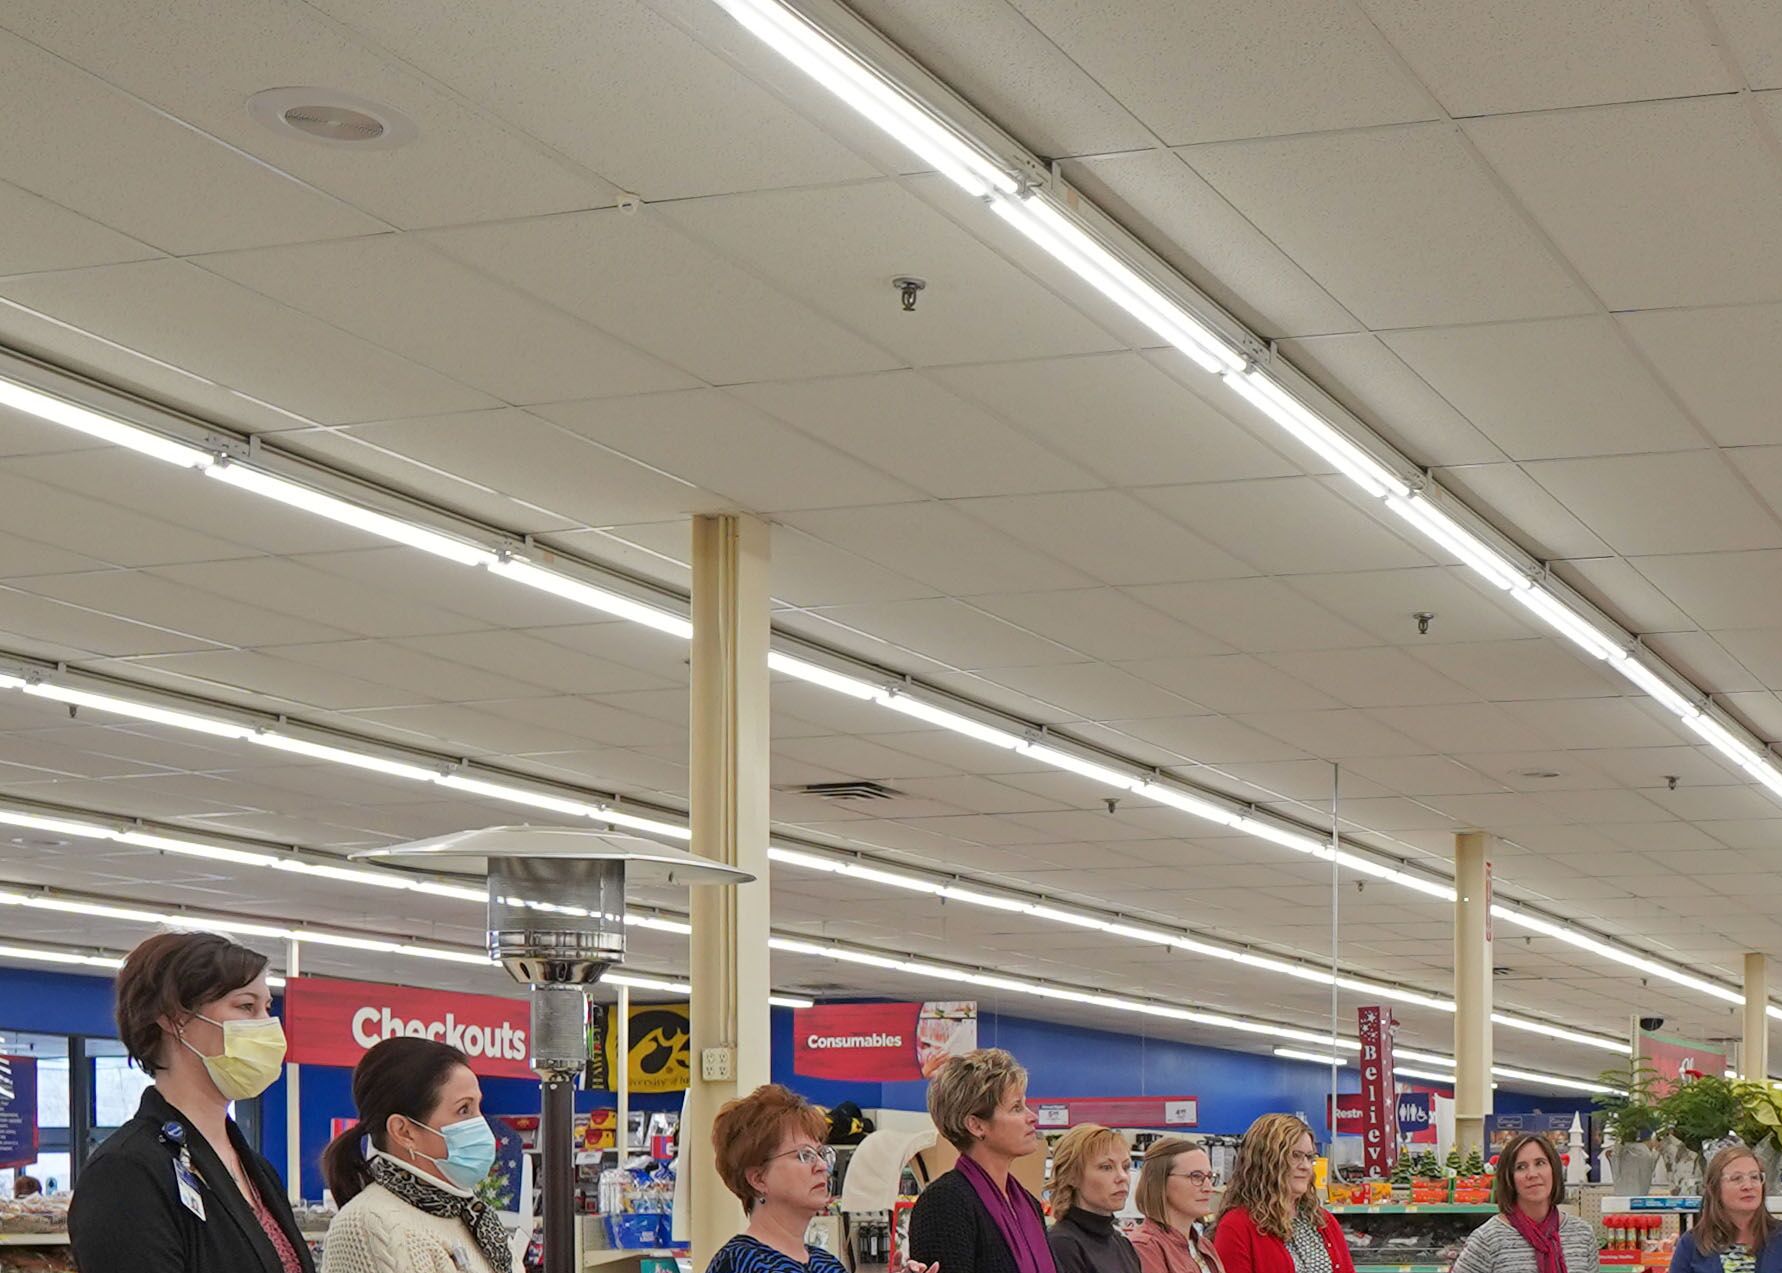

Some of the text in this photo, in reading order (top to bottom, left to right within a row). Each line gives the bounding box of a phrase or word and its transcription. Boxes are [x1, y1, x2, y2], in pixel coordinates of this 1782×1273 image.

[352, 1006, 526, 1060] Checkouts
[807, 1032, 902, 1048] Consumables
[1364, 1045, 1382, 1178] Believe
